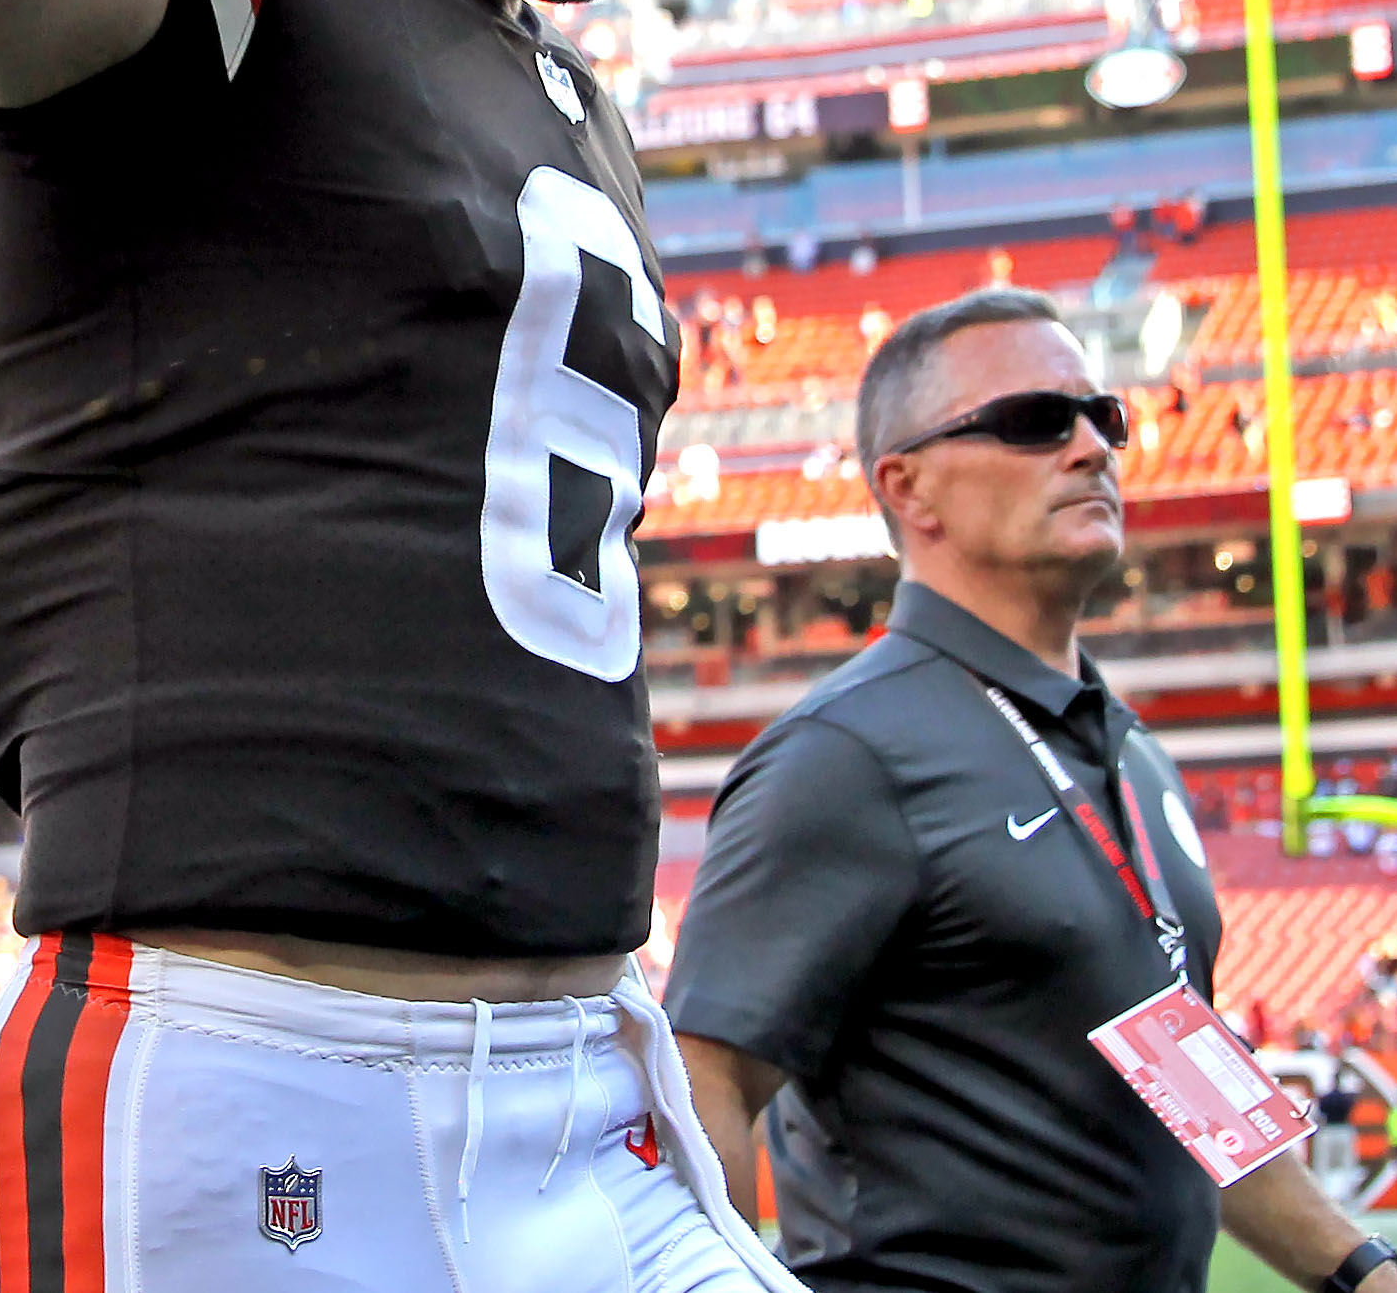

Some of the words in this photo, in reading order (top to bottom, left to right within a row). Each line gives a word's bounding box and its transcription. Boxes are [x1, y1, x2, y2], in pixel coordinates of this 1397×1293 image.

[479, 165, 667, 683] 6
[1247, 1108, 1283, 1142] 2021
[270, 1198, 313, 1234] NFL
